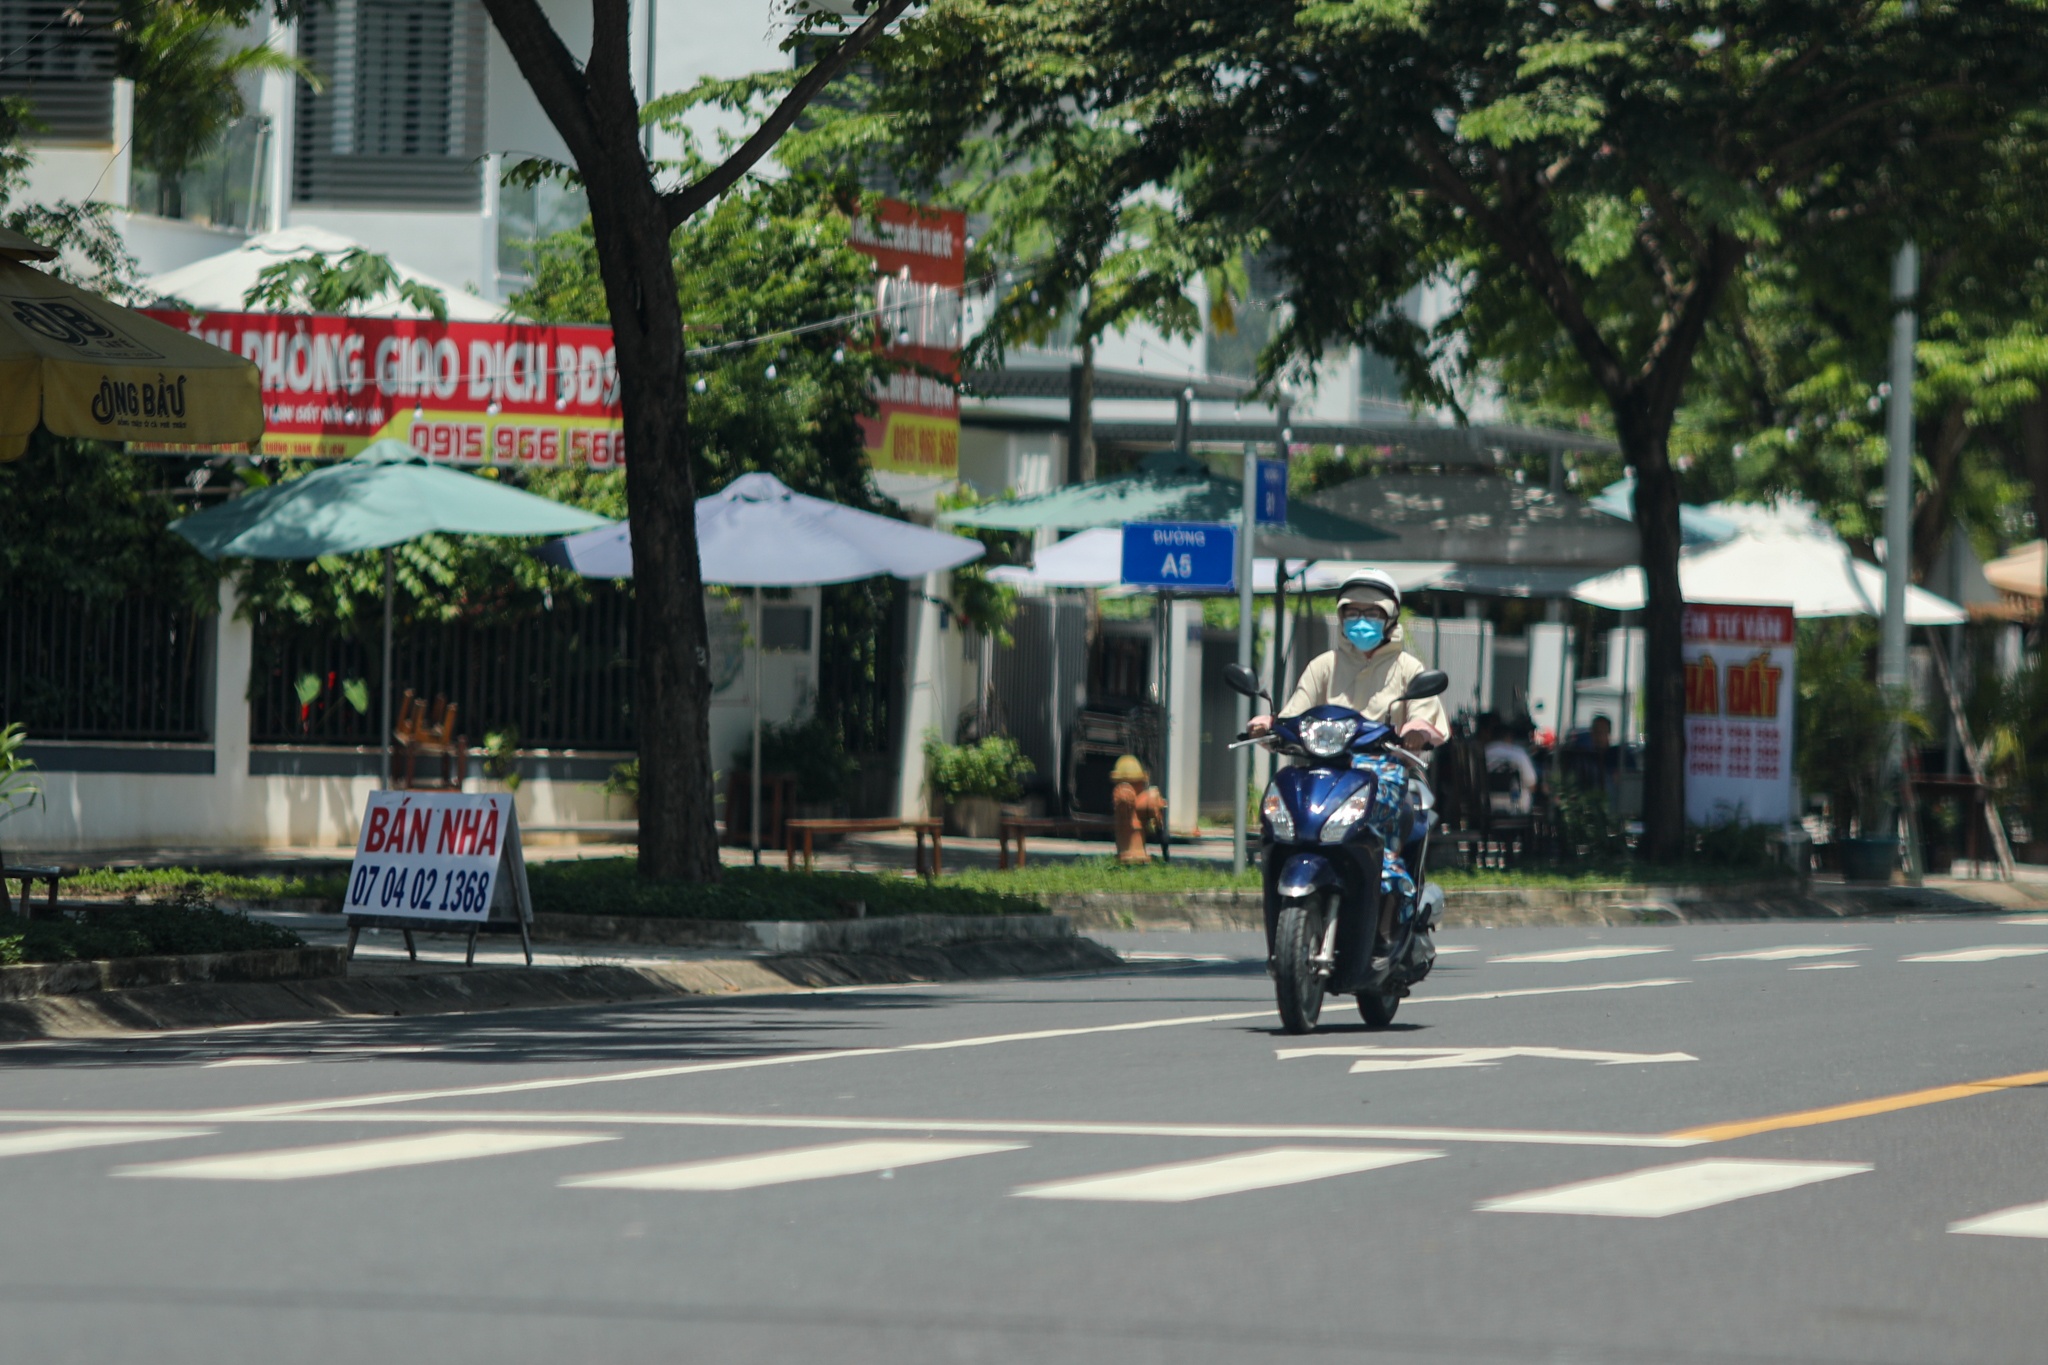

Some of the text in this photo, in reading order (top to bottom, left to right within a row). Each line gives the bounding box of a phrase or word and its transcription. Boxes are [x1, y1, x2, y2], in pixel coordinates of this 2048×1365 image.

[374, 336, 460, 399] GIAO
[91, 375, 139, 425] ÔNG
[410, 423, 485, 461] 0915
[1161, 552, 1193, 578] A5
[1684, 653, 1718, 716] HÀ
[364, 797, 499, 856] BÁN NHÀ
[351, 864, 489, 914] 07 04 02 1368
